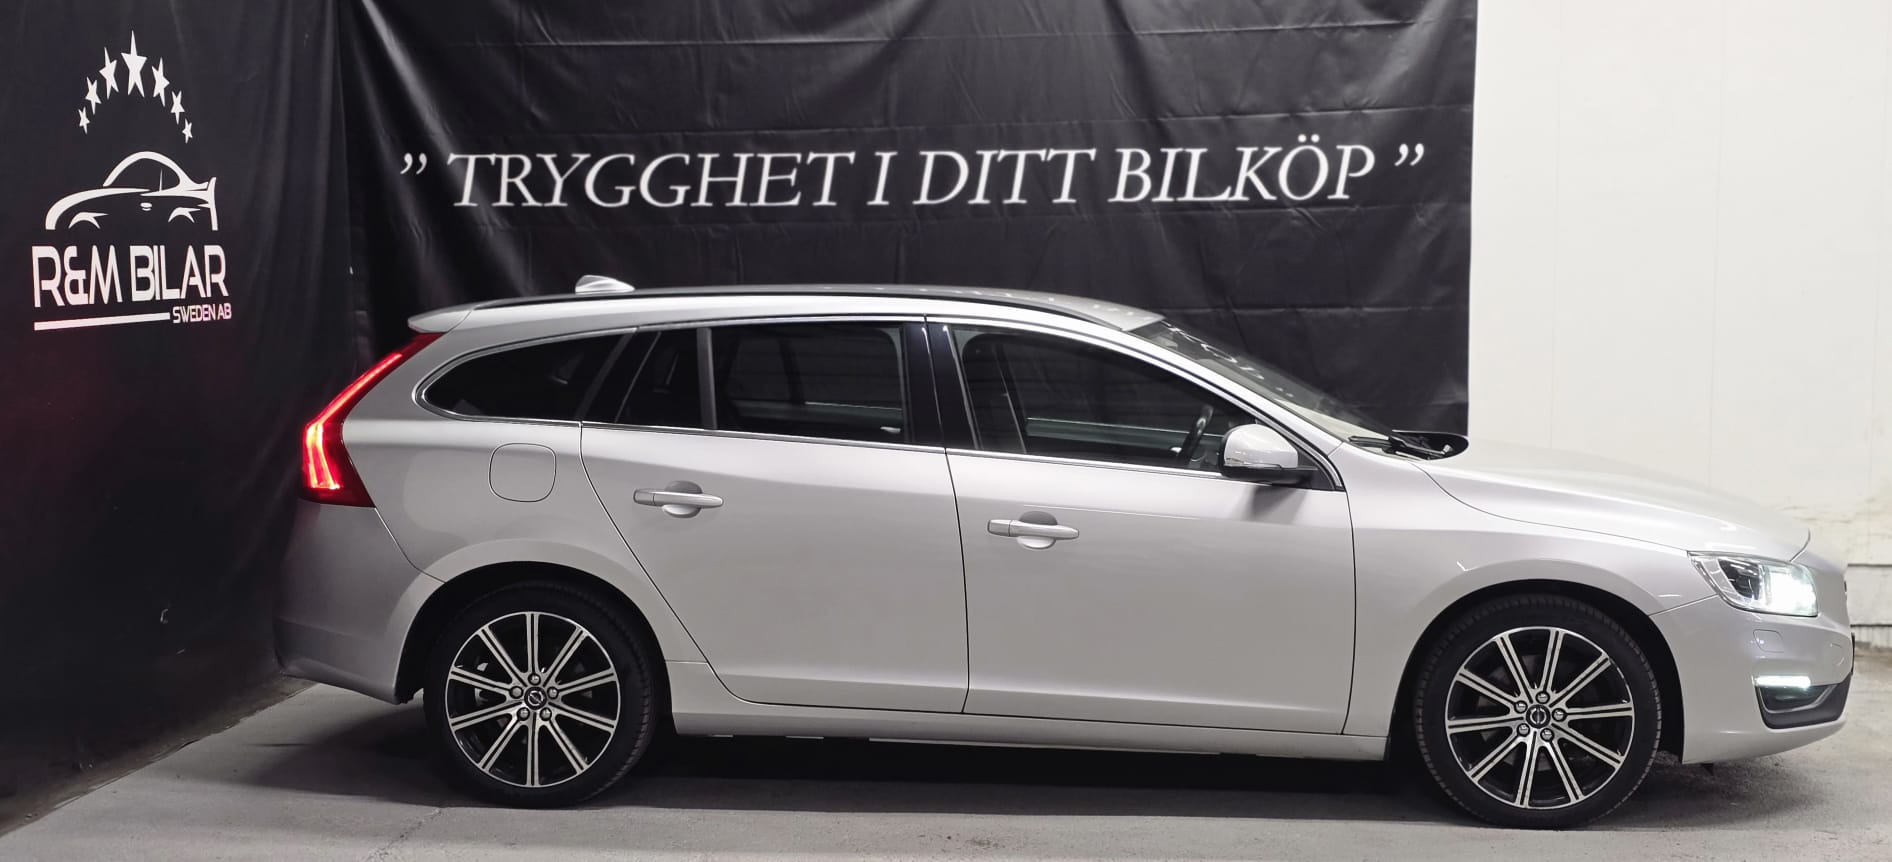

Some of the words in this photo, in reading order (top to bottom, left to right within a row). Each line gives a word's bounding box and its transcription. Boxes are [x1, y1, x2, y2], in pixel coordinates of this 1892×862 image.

[446, 151, 856, 208] TRYGGHET
[867, 151, 898, 206] I
[912, 147, 1097, 205] DITT
[1107, 133, 1376, 203] BILKÖP
[31, 244, 123, 308] R&M
[129, 244, 230, 302] BILAR
[172, 303, 216, 324] SWEDEN
[217, 302, 232, 320] AB
